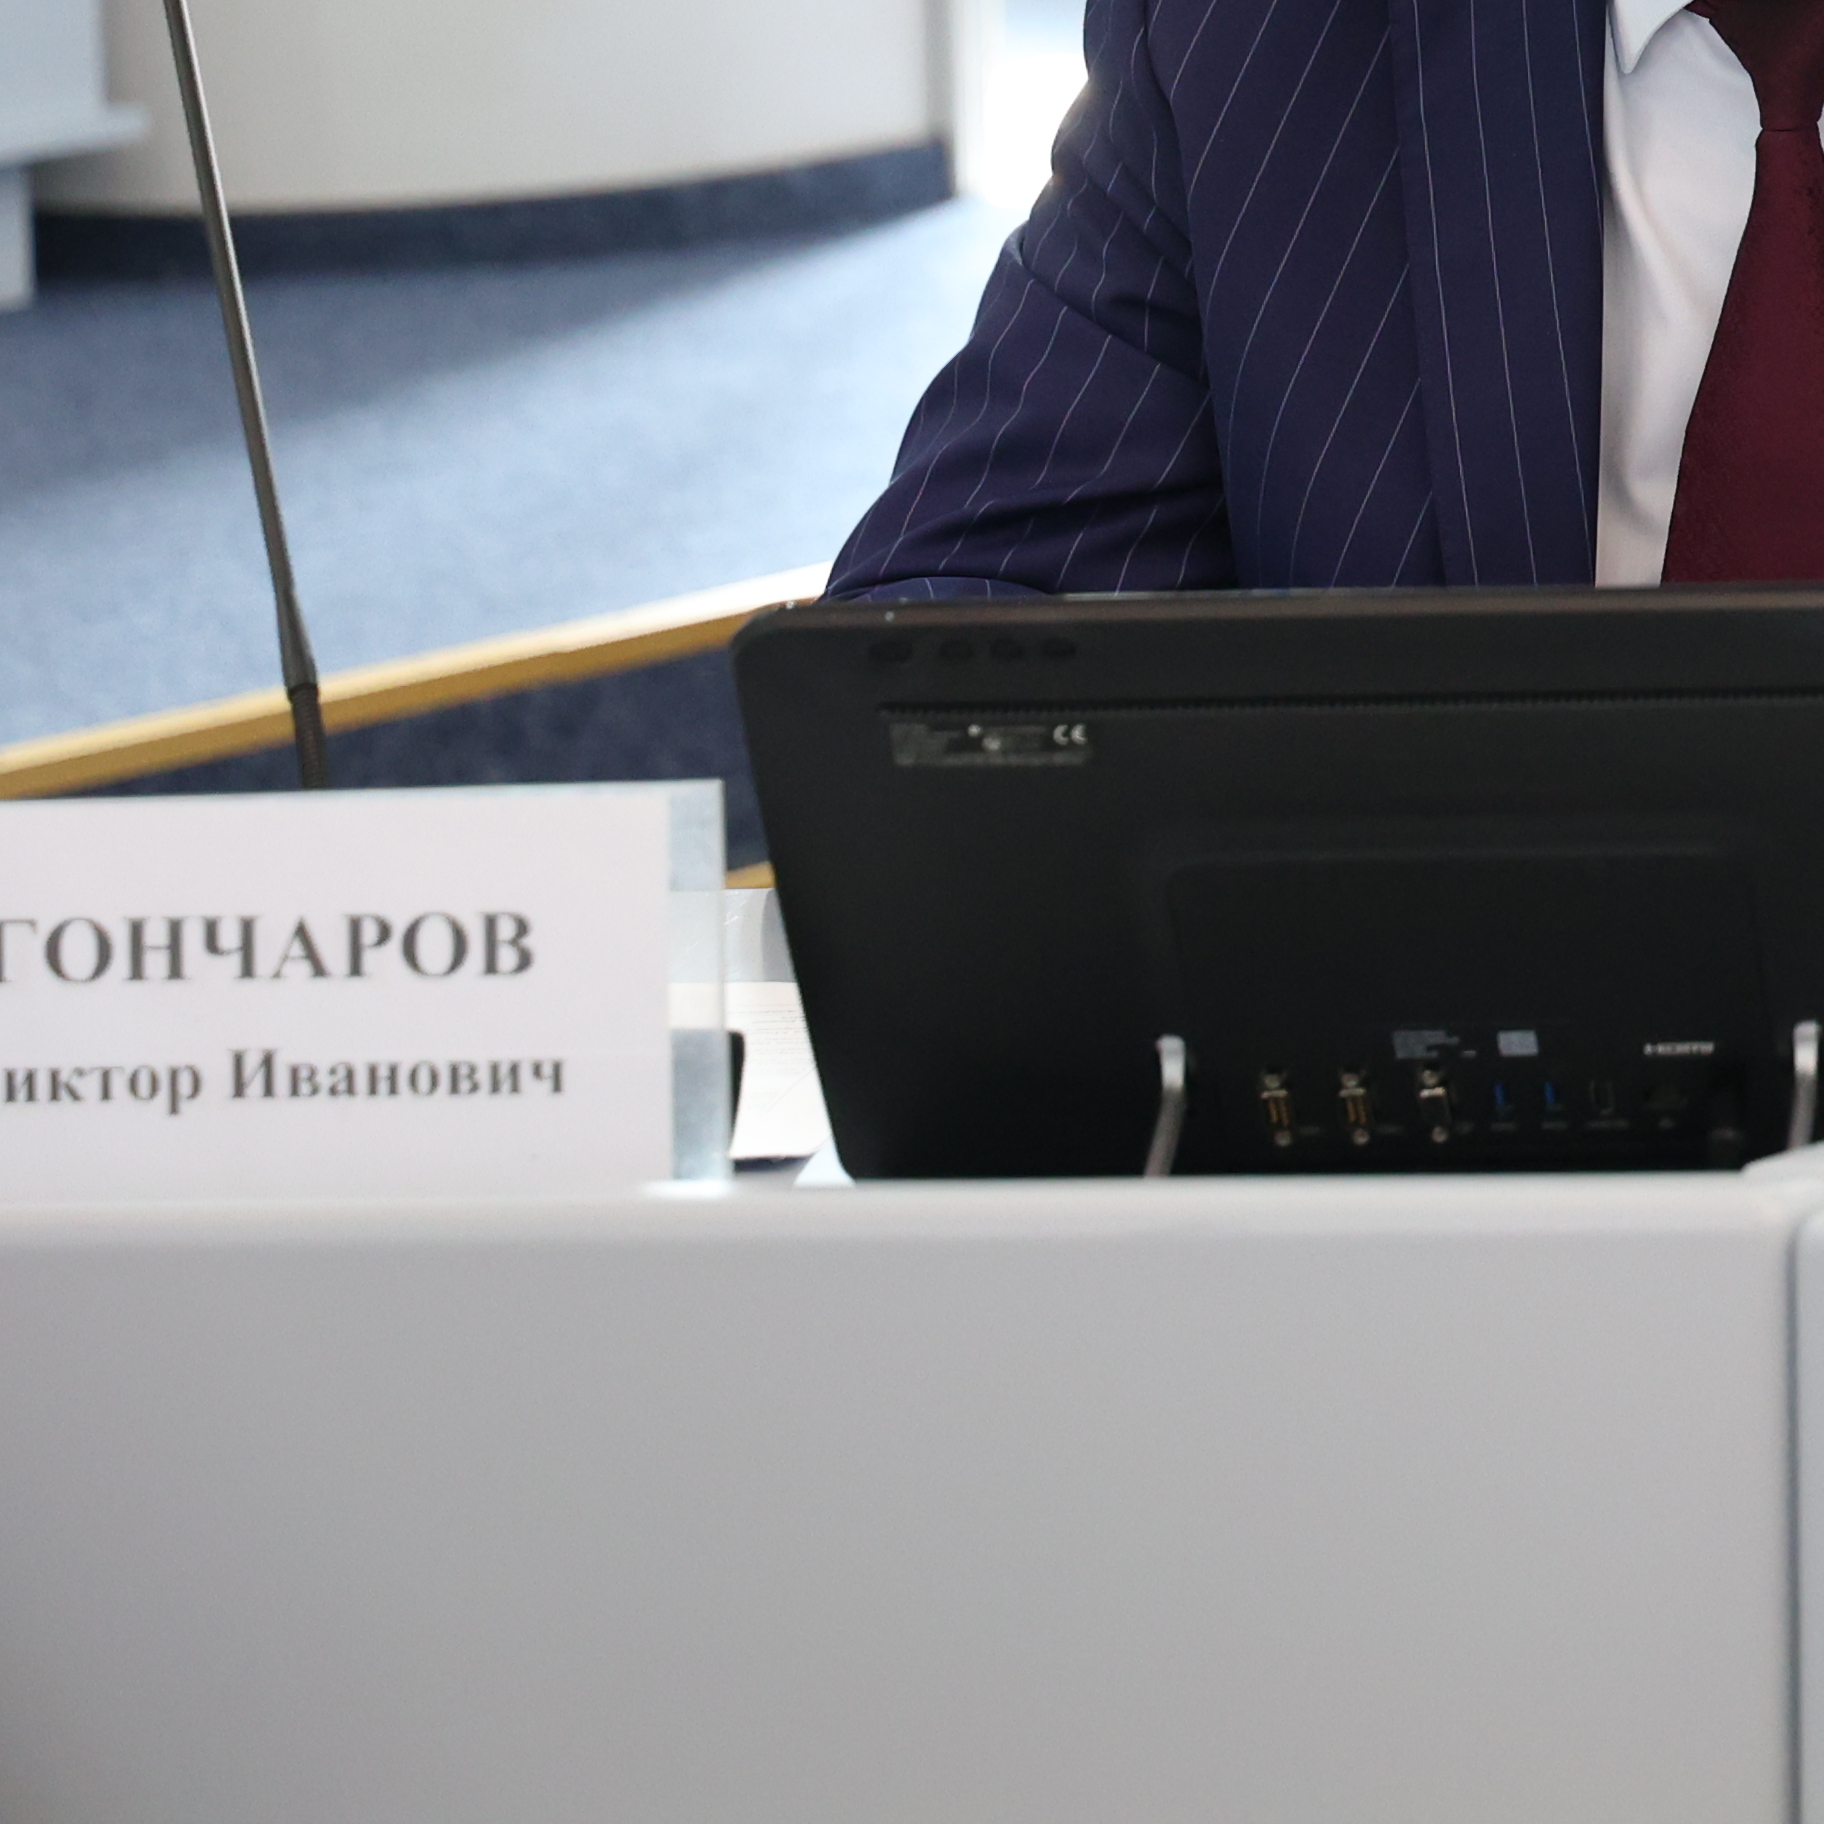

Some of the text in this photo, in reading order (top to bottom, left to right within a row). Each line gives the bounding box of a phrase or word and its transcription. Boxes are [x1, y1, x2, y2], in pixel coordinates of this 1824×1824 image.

[0, 911, 535, 984] ГОНЧАРОВ
[2, 1048, 568, 1117] иктор Иванович
